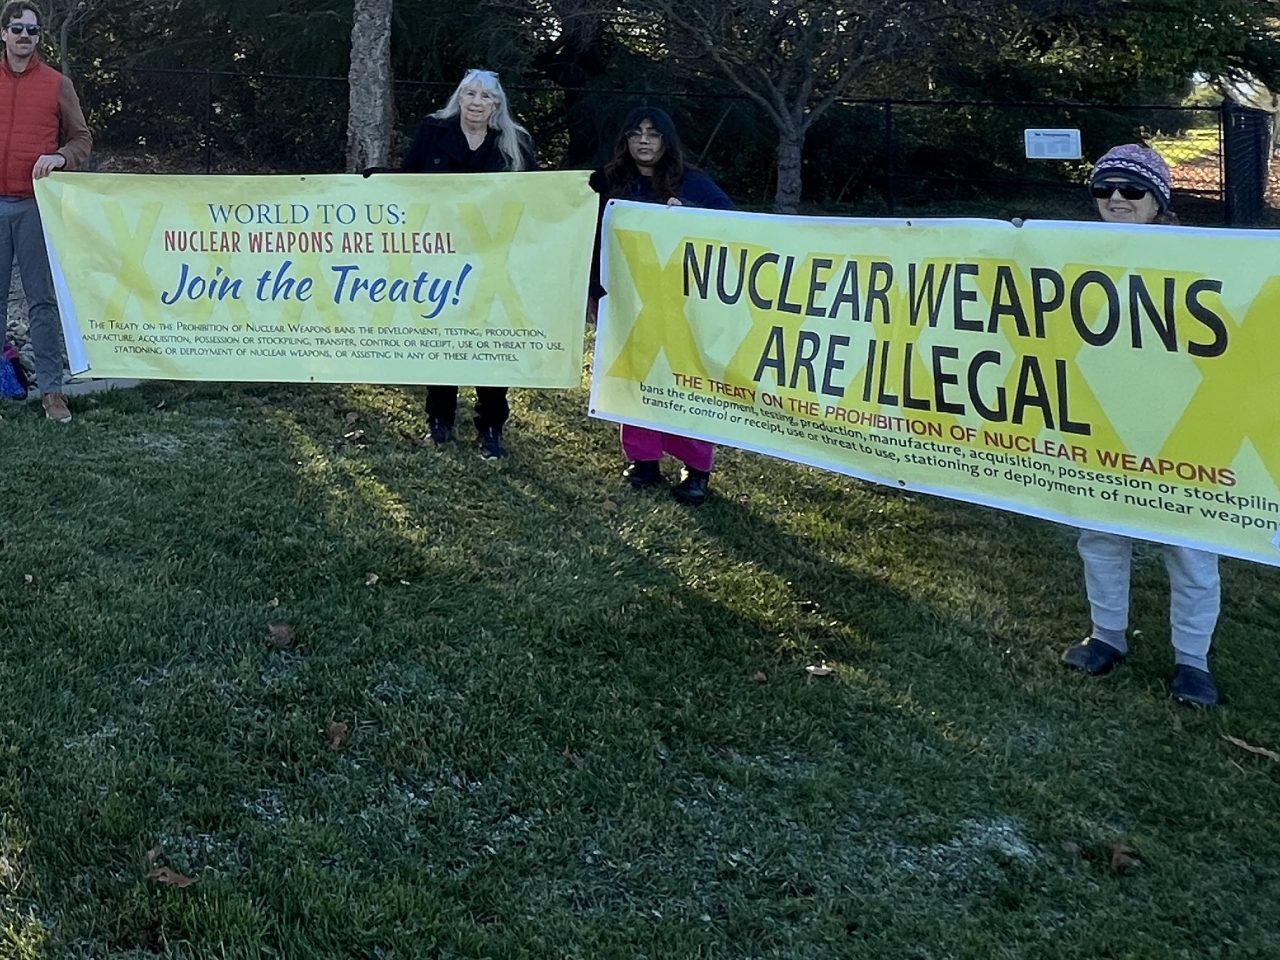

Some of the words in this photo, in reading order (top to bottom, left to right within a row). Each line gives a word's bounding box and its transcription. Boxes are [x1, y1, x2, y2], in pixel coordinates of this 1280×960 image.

[164, 231, 241, 253] NUCLEAR
[248, 231, 335, 254] WEAPONS
[342, 232, 375, 254] ARE
[382, 232, 456, 254] ILLEGAL
[207, 204, 309, 226] WORLD
[317, 204, 357, 225] TO
[365, 204, 406, 226] US:
[161, 263, 243, 305] Join
[256, 260, 313, 302] the
[330, 263, 472, 319] Treaty!
[682, 242, 893, 325] NUCLEAR
[908, 263, 1229, 358] WEAPONS
[672, 373, 702, 389] THE
[707, 379, 756, 402] TREATY
[762, 392, 784, 409] ON
[788, 398, 819, 416] THE
[825, 406, 942, 437] PROHIBITION
[950, 425, 977, 441] OF
[984, 431, 1087, 463] NUCLEAR
[1096, 449, 1236, 487] WEAPONS
[754, 326, 850, 396] ARE
[862, 340, 1090, 436] ILLEGAL
[639, 382, 664, 396] bans
[668, 388, 685, 400] the
[687, 391, 759, 416] development,
[760, 407, 799, 427] testing,
[800, 418, 867, 441] production,
[869, 432, 966, 458] manufacture,
[969, 449, 1055, 475] acquisition,
[1058, 465, 1152, 491] possession
[1159, 482, 1177, 494] or
[642, 396, 686, 414] transfer,
[689, 405, 728, 421] control
[730, 414, 742, 424] or
[744, 417, 785, 436] receipt,
[787, 427, 805, 438] use
[808, 431, 820, 441] or
[821, 434, 858, 451] threat
[860, 442, 873, 455] to
[875, 447, 900, 463] use,
[904, 451, 980, 477] stationing
[984, 467, 999, 477] or
[1004, 469, 1094, 498] deployment
[1100, 488, 1119, 501] of
[1124, 492, 1194, 515] nuclear
[1200, 507, 1280, 531] weapon
